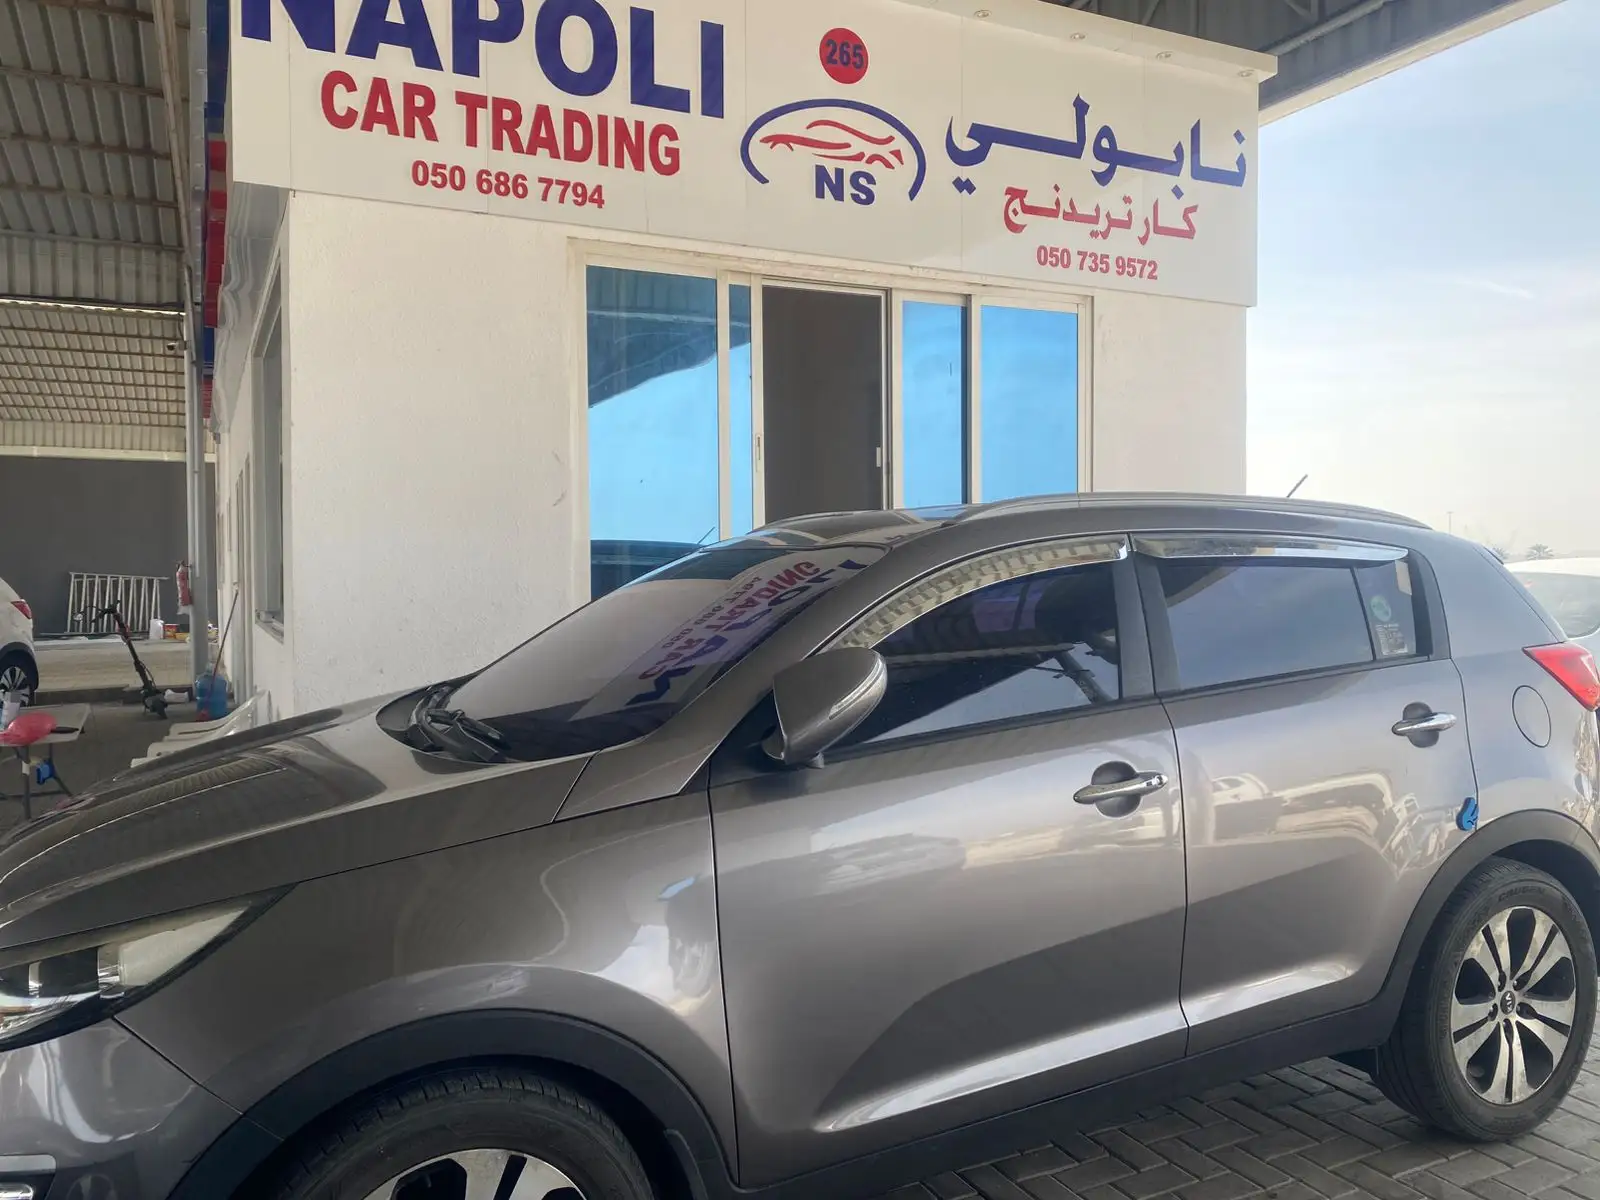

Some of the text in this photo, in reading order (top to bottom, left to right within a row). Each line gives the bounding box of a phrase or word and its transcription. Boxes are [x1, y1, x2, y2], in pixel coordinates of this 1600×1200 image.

[825, 38, 865, 69] 265
[320, 69, 681, 177] CAR TRADING
[945, 93, 1247, 200] نابولي
[411, 159, 605, 209] 050 686 7794
[814, 165, 877, 206] NS
[1003, 184, 1199, 246] كار تريدنج
[1036, 245, 1158, 280] 050 735 9572
